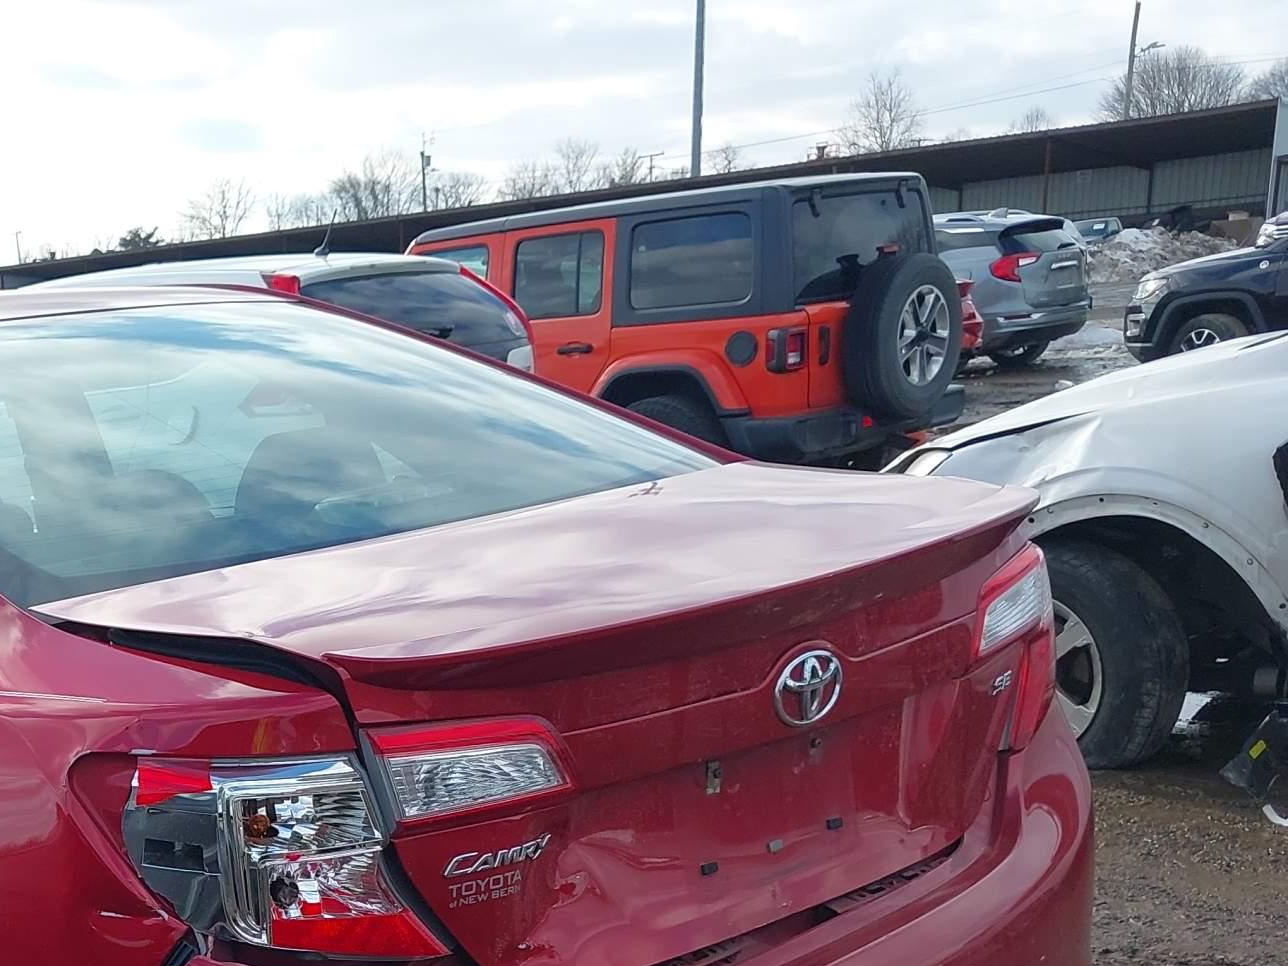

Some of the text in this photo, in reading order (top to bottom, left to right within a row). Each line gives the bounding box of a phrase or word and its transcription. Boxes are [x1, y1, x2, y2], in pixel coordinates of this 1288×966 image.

[441, 833, 551, 877] CAMRY
[448, 869, 522, 898] TOYOTA
[458, 892, 489, 908] NEW
[491, 884, 521, 899] BERN
